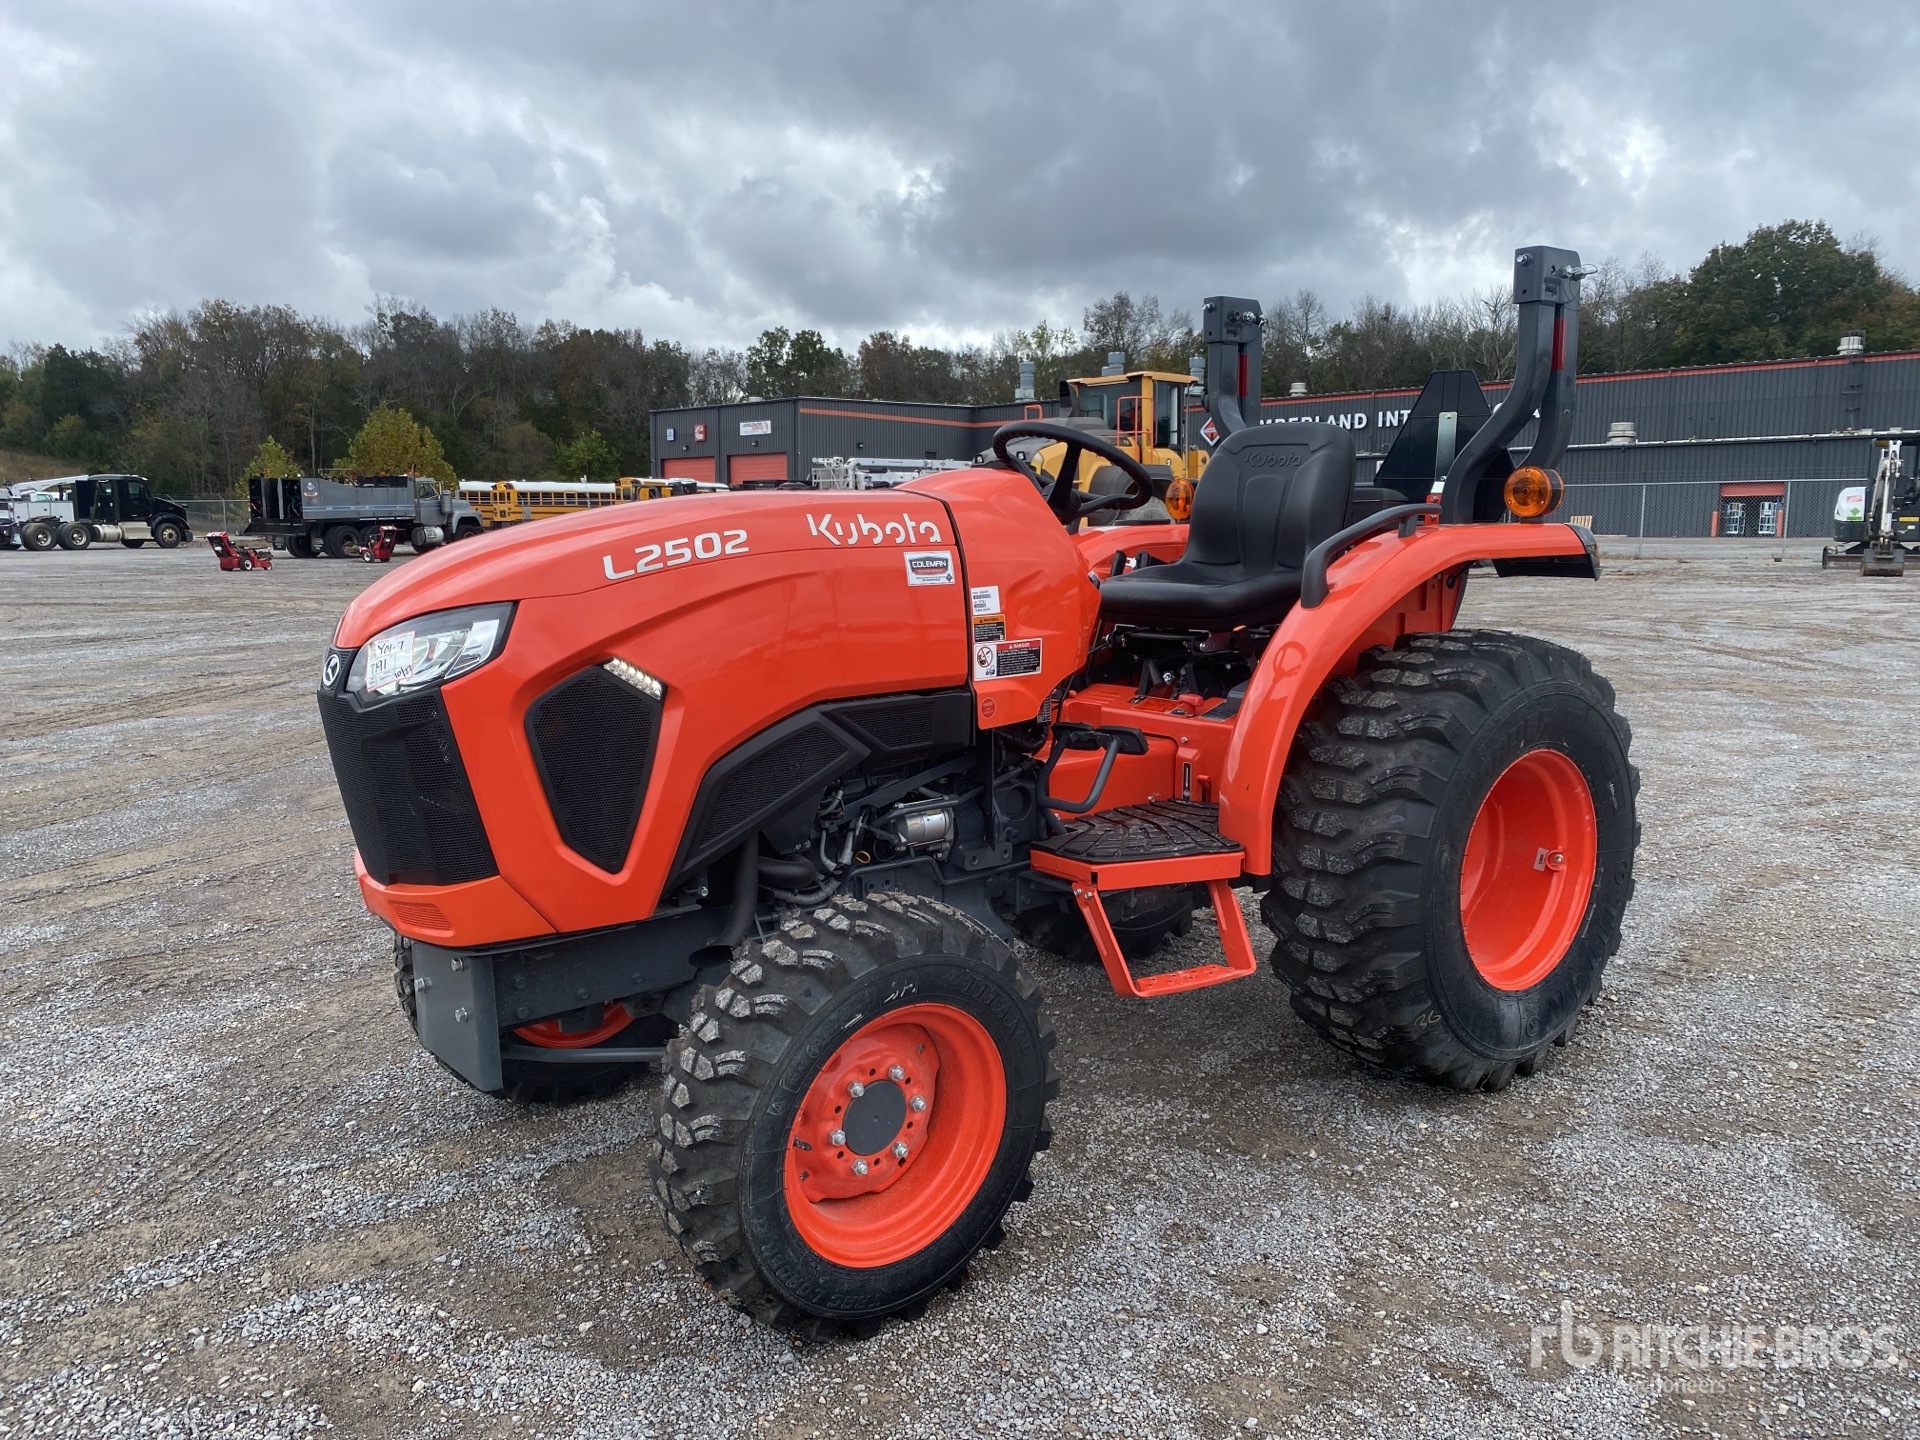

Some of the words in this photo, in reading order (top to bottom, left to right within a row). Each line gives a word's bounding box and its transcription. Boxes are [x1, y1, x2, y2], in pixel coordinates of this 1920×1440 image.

[1244, 451, 1302, 468] Kubota
[805, 512, 942, 546] Kubota
[602, 528, 750, 580] L2502
[911, 560, 947, 568] COLEMAN
